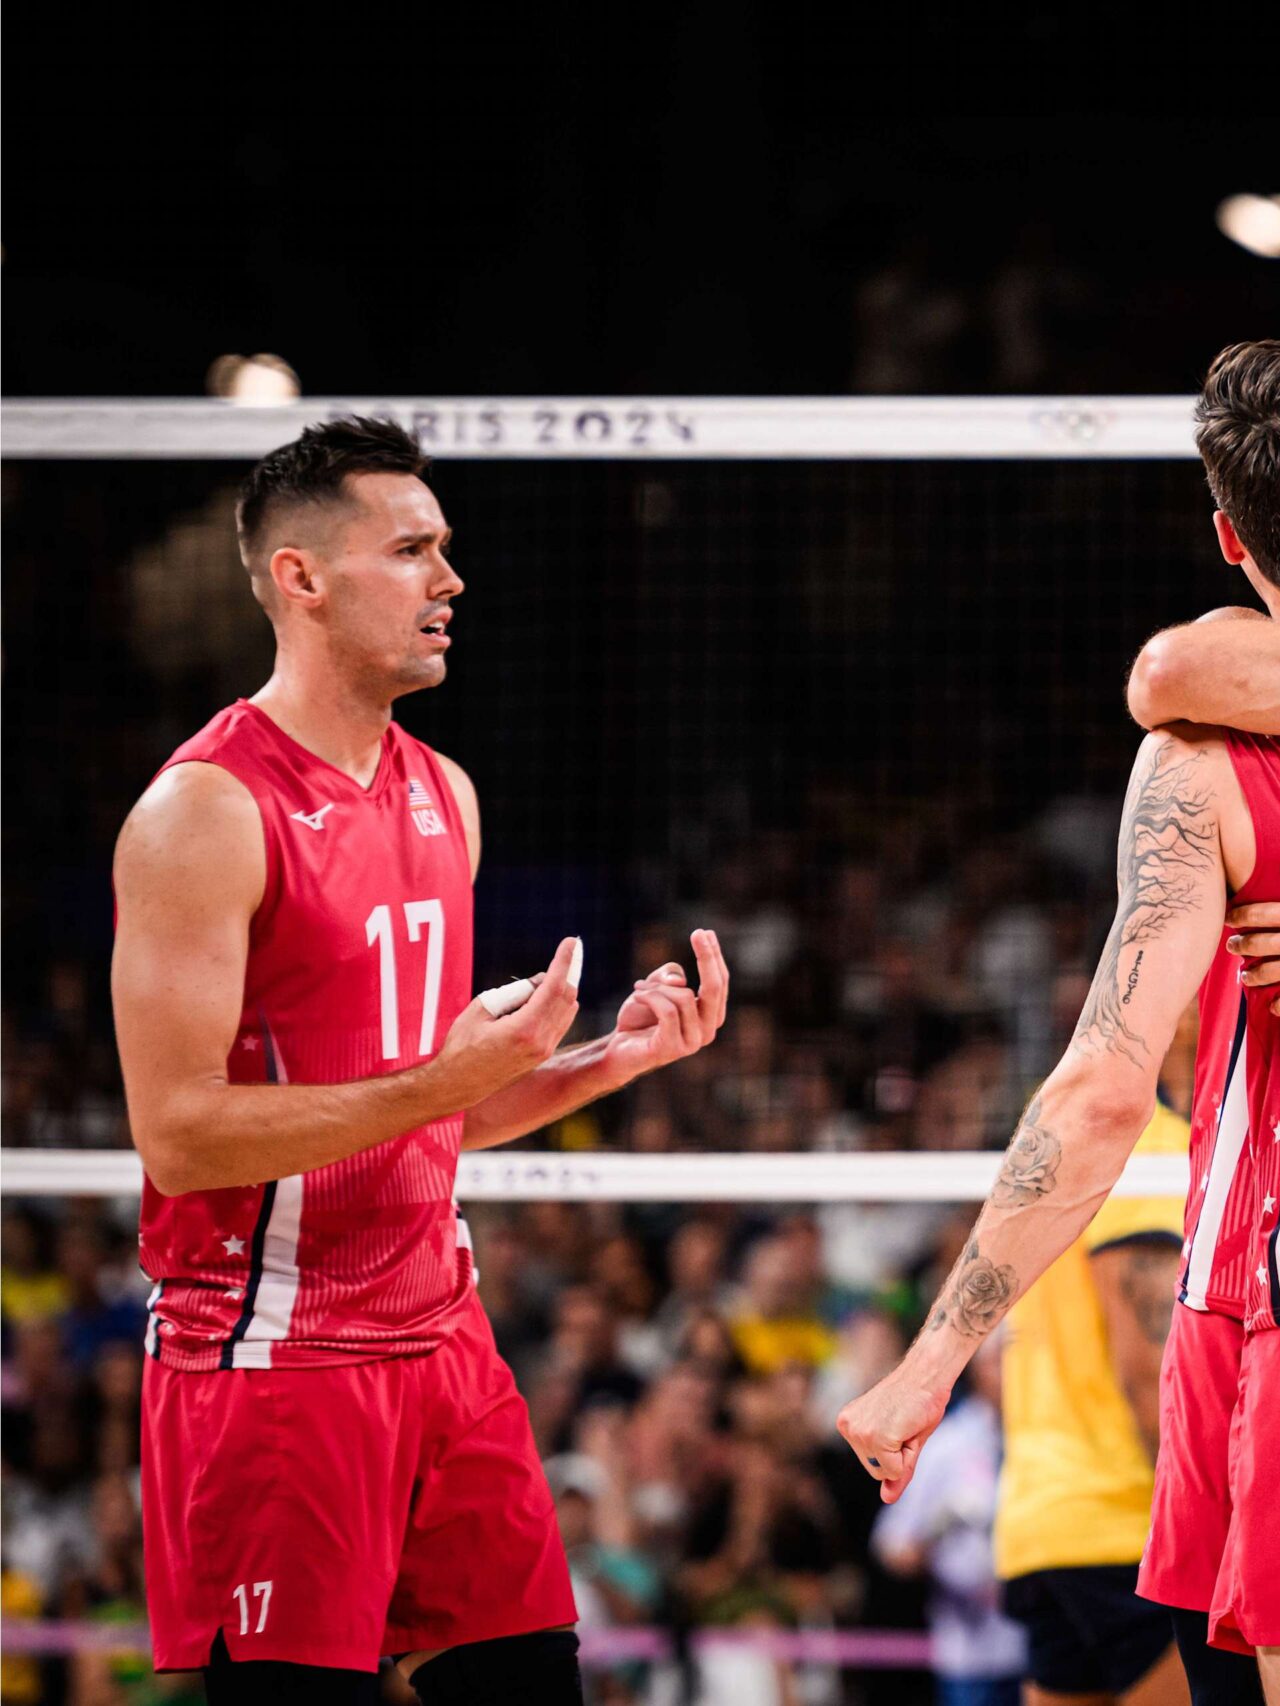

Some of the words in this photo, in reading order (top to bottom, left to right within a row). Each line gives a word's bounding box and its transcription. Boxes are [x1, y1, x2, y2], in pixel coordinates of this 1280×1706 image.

[327, 410, 503, 443] RIS
[532, 410, 693, 443] 2024
[411, 809, 447, 836] USA
[365, 899, 445, 1059] 17
[233, 1581, 273, 1635] 17
